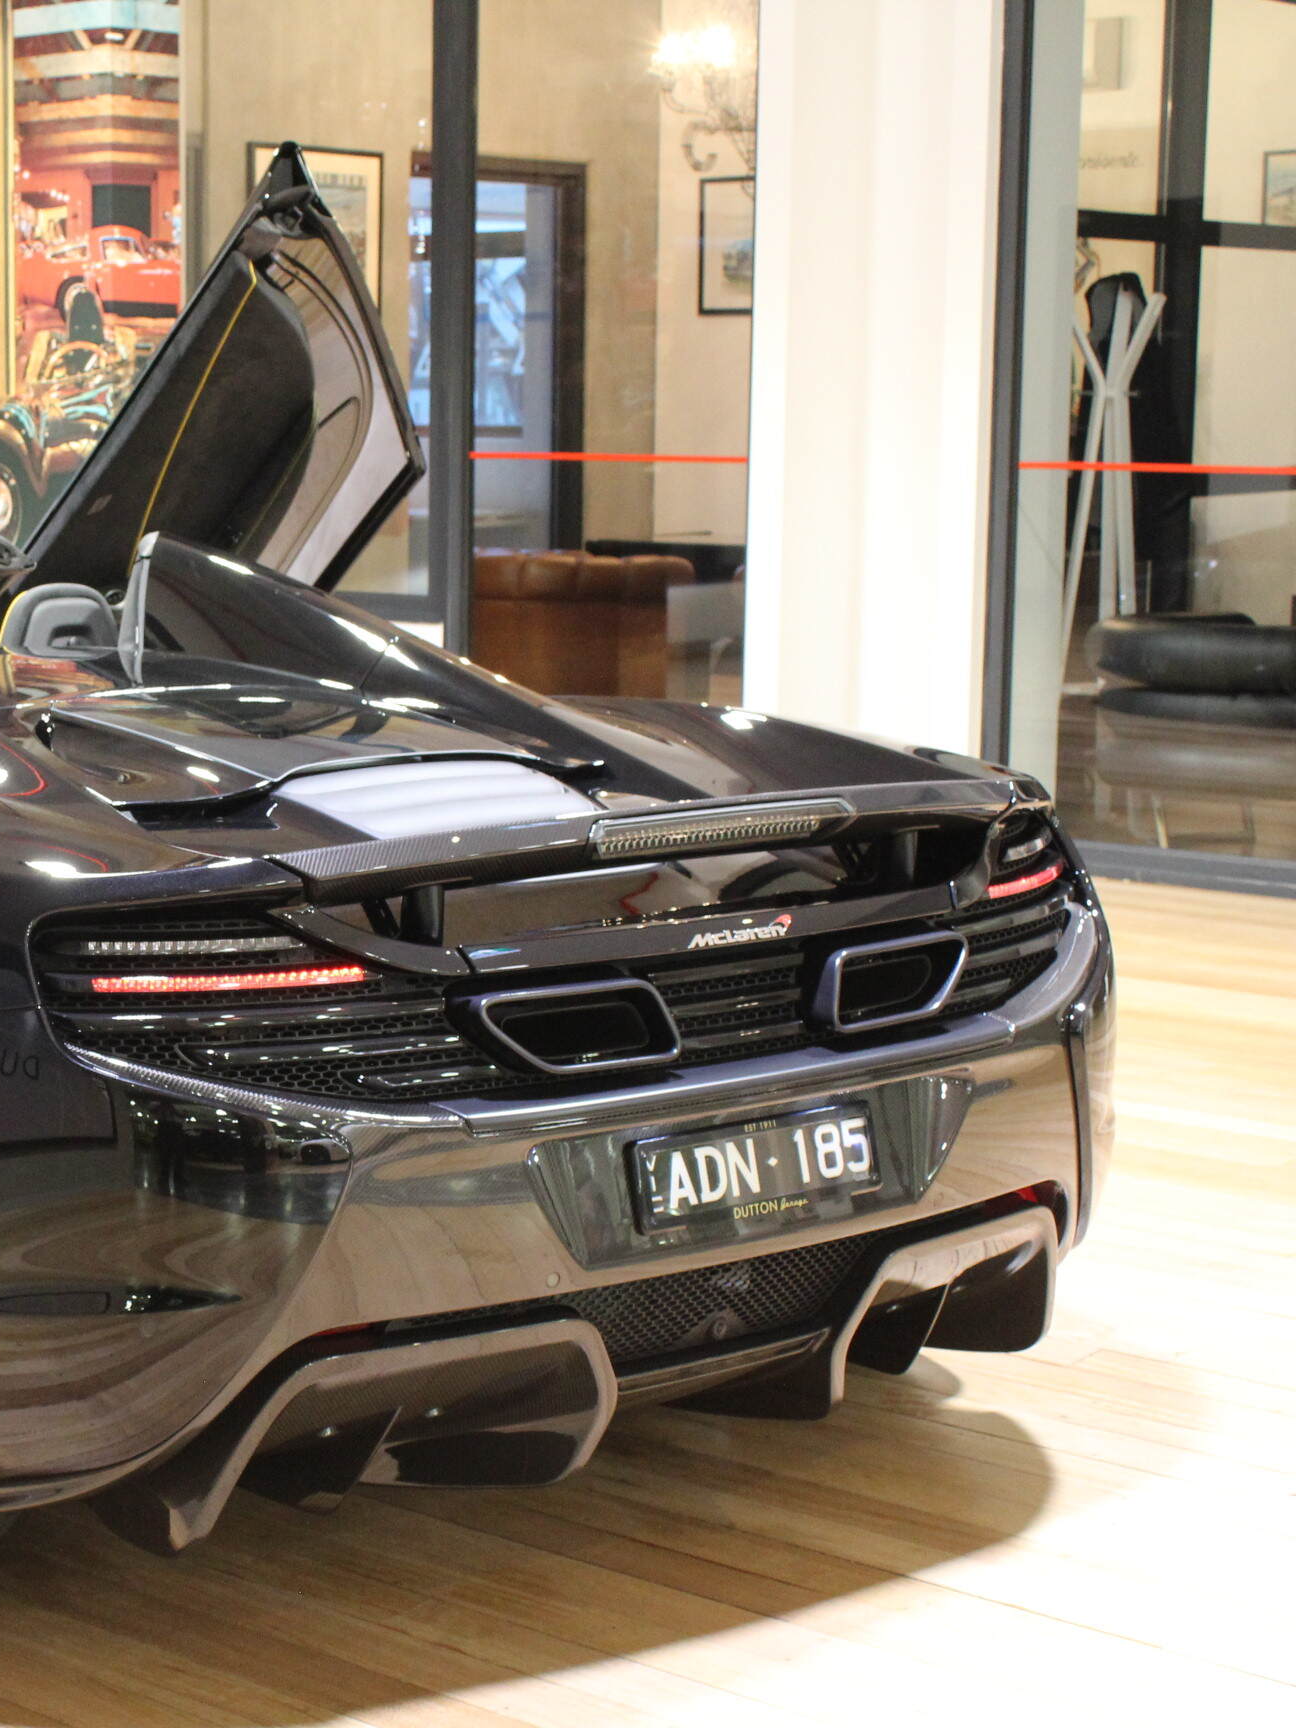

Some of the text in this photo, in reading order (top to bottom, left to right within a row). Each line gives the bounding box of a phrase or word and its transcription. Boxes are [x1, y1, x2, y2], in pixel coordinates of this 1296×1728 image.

[688, 924, 787, 949] McLaren
[669, 1118, 870, 1210] ADN 185
[733, 1199, 779, 1219] DUTTON
